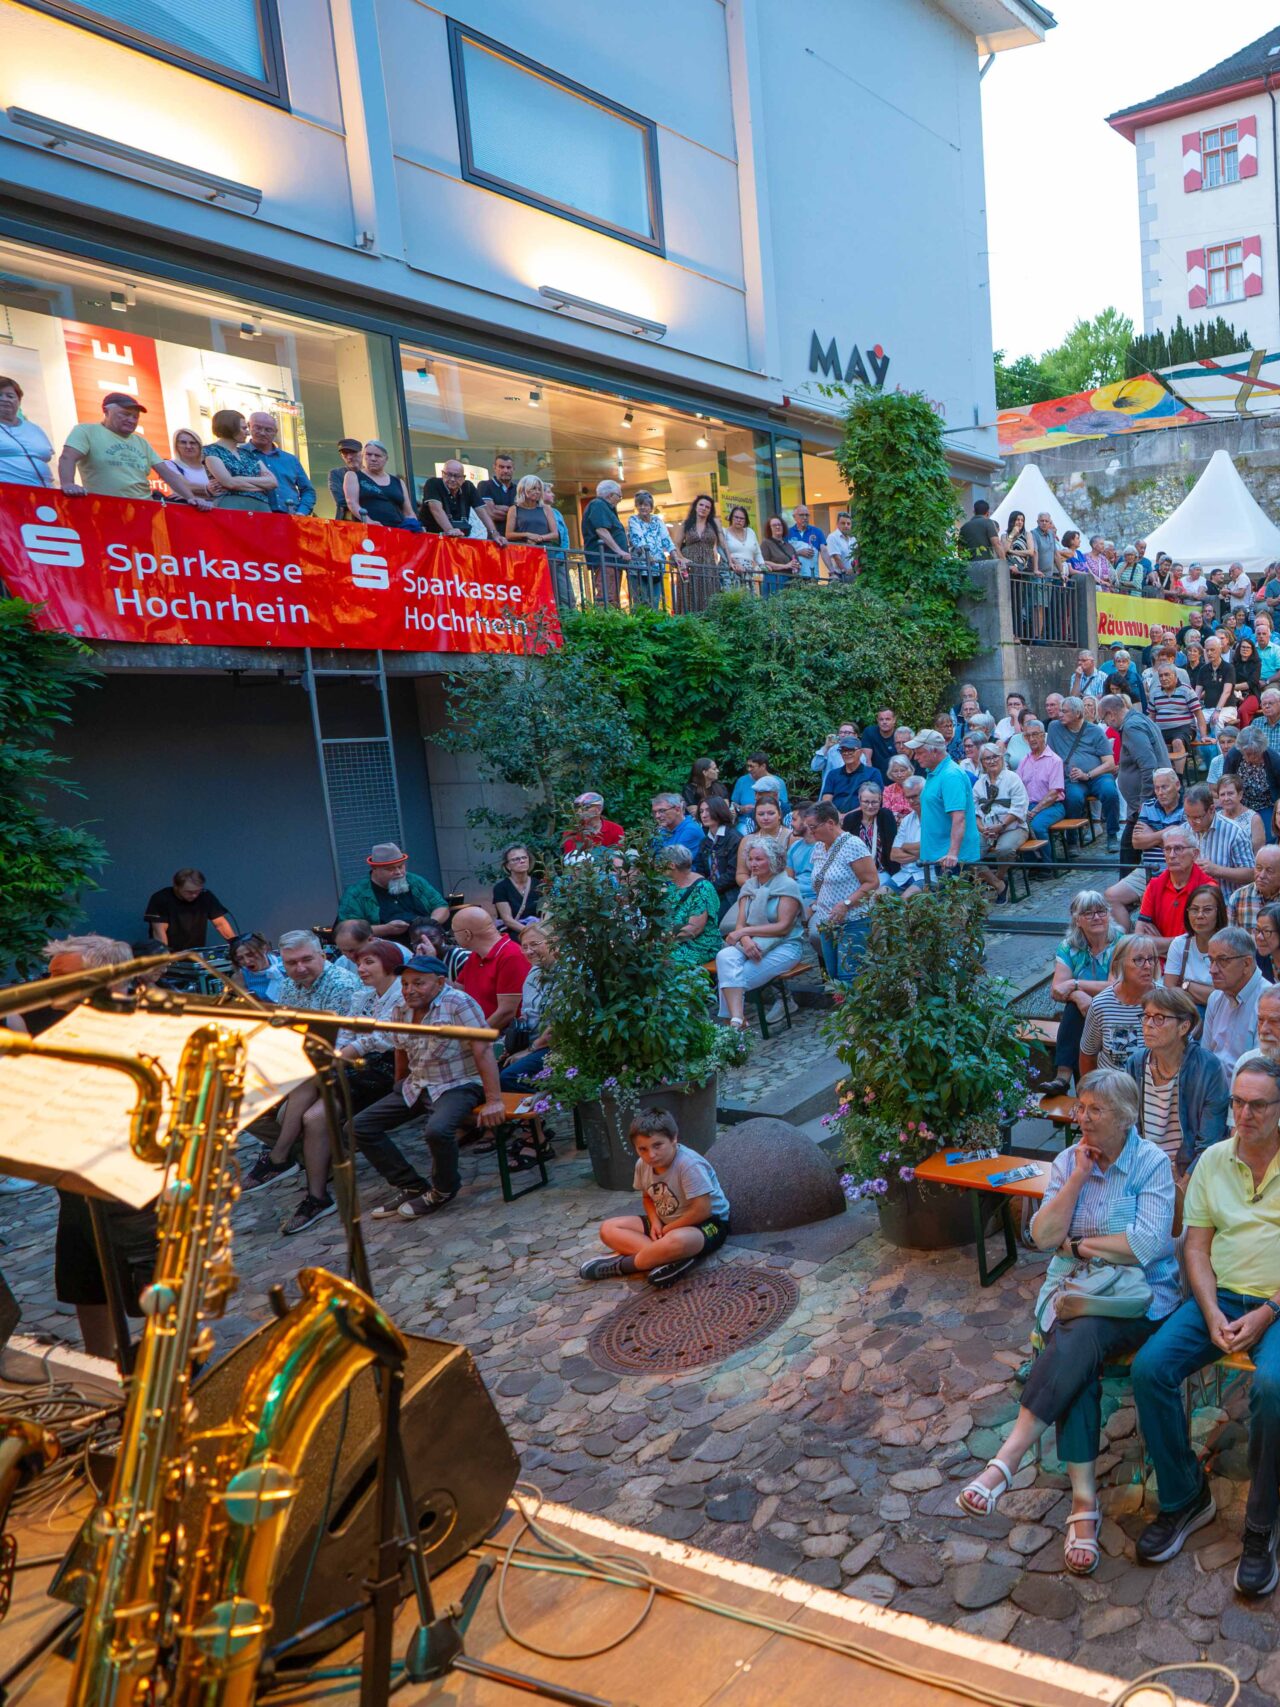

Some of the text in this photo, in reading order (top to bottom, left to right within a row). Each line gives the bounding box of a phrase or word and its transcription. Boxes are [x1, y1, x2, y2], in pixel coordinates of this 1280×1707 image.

[809, 329, 890, 391] MAY
[107, 543, 303, 584] Sparkasse
[402, 569, 522, 602] Sparkasse
[114, 587, 310, 624] Hochrhein
[404, 606, 529, 636] Hochrhein
